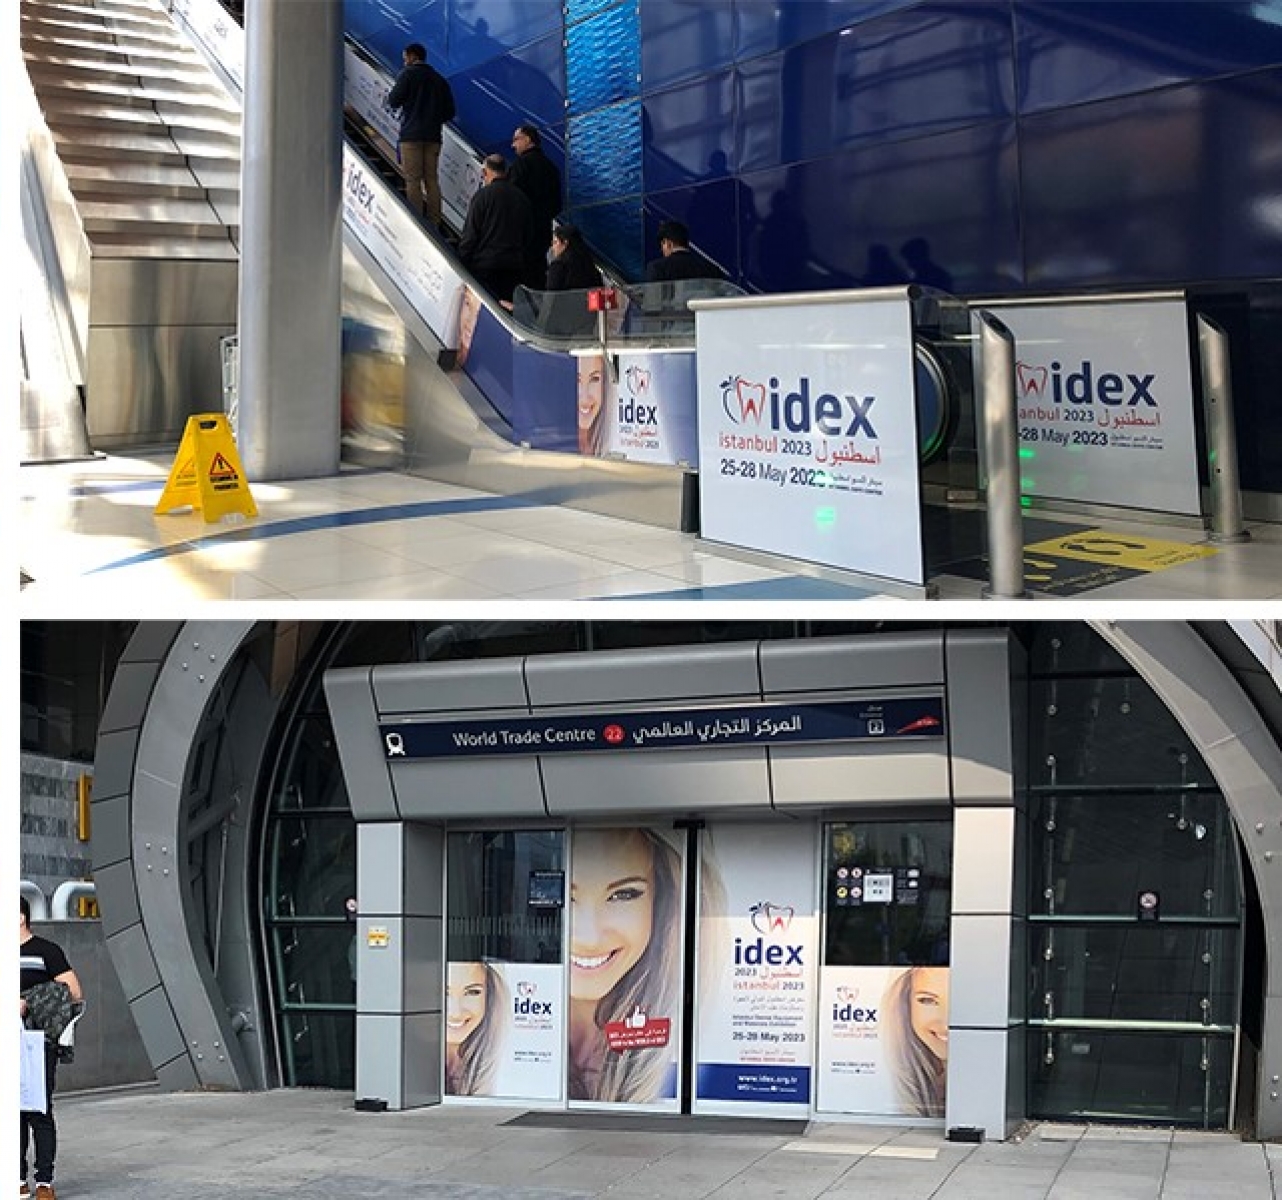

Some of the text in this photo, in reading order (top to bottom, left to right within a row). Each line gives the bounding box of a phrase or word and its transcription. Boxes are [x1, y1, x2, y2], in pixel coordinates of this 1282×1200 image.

[346, 163, 376, 214] idex
[1051, 361, 1158, 407] idex
[619, 398, 657, 425] idex
[769, 376, 878, 439] idex
[1019, 407, 1094, 423] anbul 2023
[1097, 409, 1161, 429] اسطنبول
[719, 432, 812, 456] istanbul 2023
[1041, 428, 1070, 447] May
[1072, 430, 1109, 446] 2023
[815, 440, 882, 467] اسطنبول
[721, 458, 756, 478] 25-28
[759, 462, 788, 487] May
[453, 726, 596, 747] World Trade Centre
[633, 715, 802, 744] المركز التجاري العالمي
[735, 937, 803, 966] idex
[514, 997, 552, 1015] idex
[833, 1003, 877, 1022] idex
[761, 1031, 779, 1043] May
